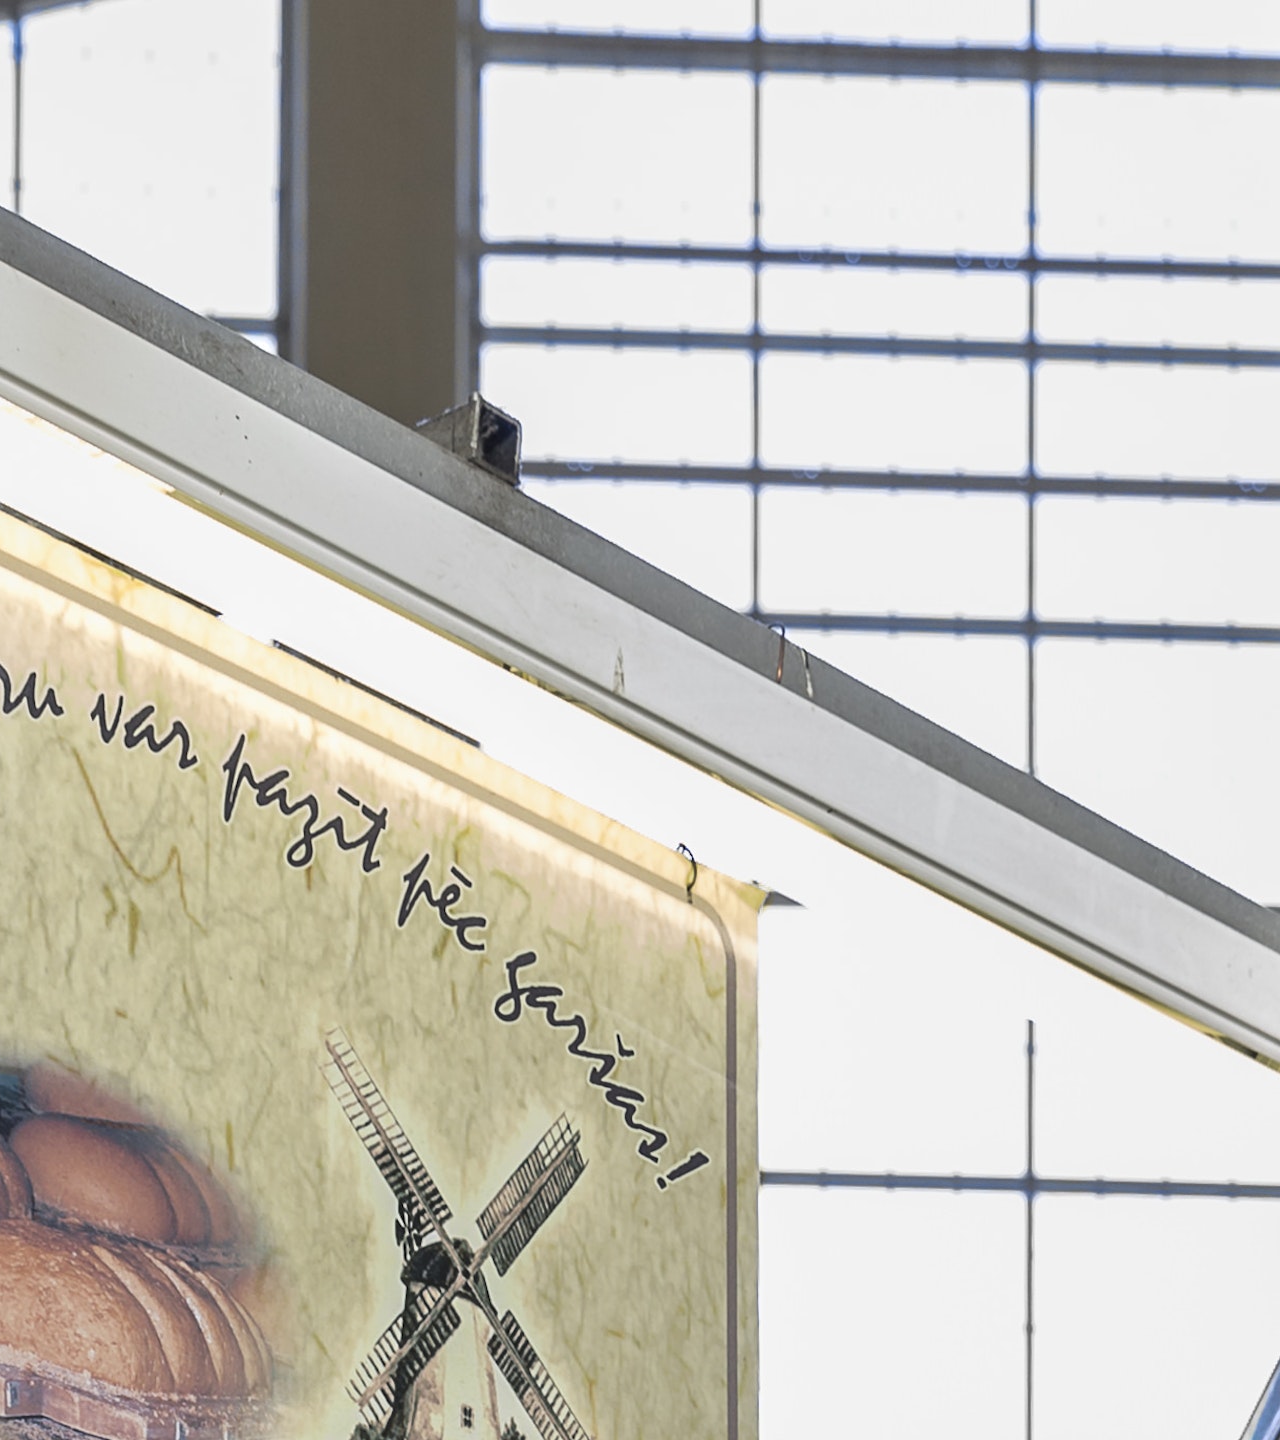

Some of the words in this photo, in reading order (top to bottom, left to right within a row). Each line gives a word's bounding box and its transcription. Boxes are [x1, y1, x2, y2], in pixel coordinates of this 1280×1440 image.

[89, 694, 199, 771] var
[223, 733, 389, 873] pazīt
[400, 851, 486, 954] pēc
